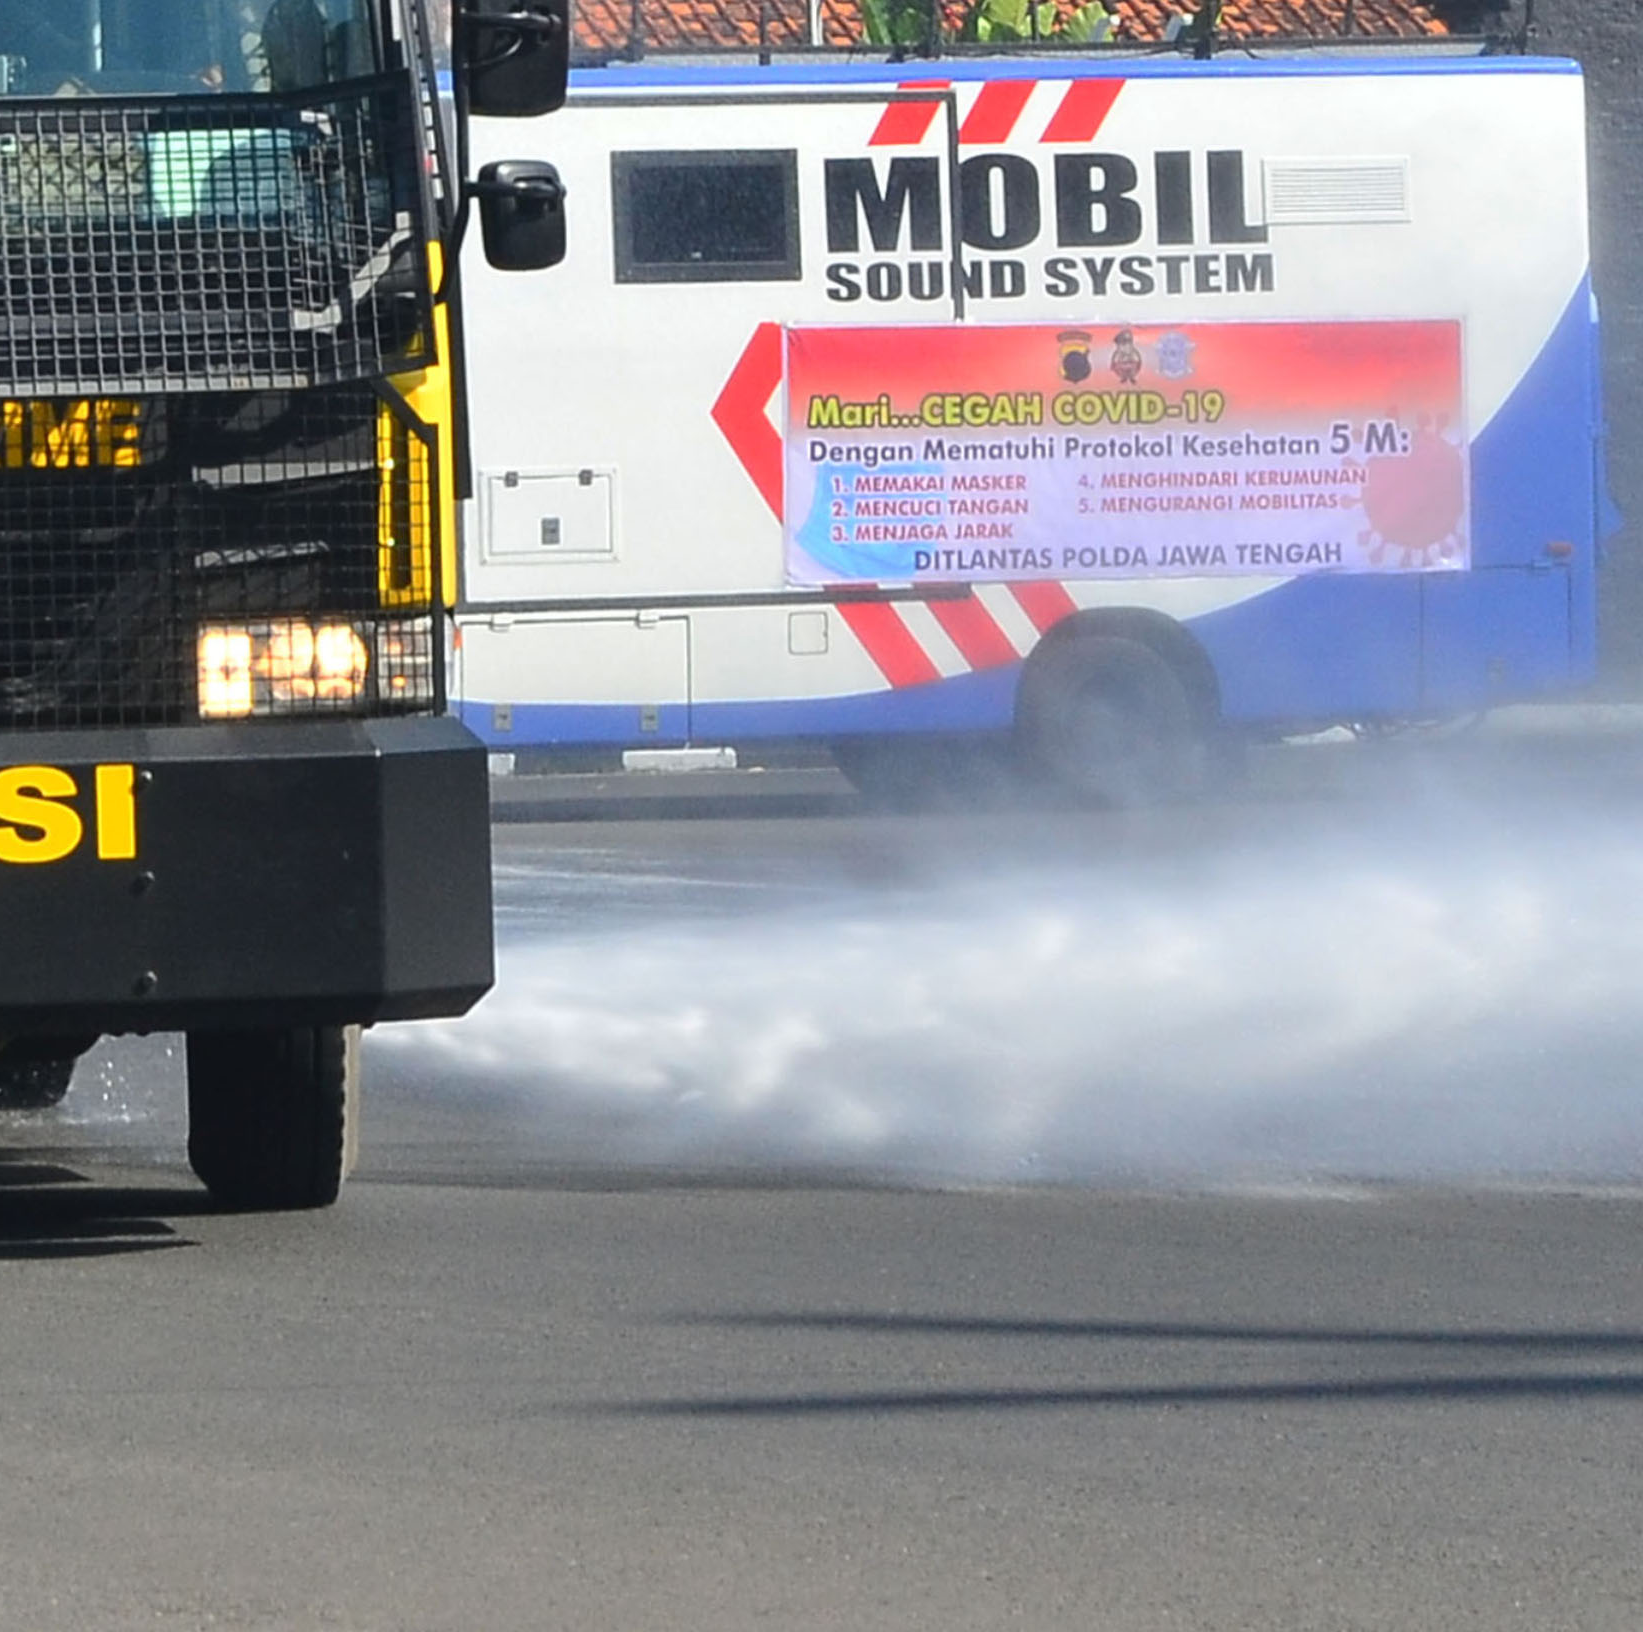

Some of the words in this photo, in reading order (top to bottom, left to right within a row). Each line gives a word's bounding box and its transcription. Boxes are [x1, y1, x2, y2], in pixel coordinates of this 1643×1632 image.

[823, 149, 1270, 254] MOBIL
[826, 259, 1027, 302] SOUND
[1044, 253, 1275, 300] SYSTEM
[1052, 389, 1225, 426] COVID-19
[809, 440, 913, 467] Dengan
[923, 435, 1055, 461] Mematuhi
[1064, 434, 1172, 458] Protokol
[1182, 432, 1321, 457] Kesehatan
[1330, 423, 1351, 455] 5
[1365, 421, 1410, 454] M:
[832, 476, 849, 493] 1.
[854, 475, 944, 493] MEMAKAI
[950, 474, 1027, 491] MASKER
[1078, 473, 1096, 489] 4.
[1100, 471, 1238, 489] MENGHINDARI
[1245, 469, 1367, 487] KERUMUNAN
[832, 500, 849, 518] 2.
[854, 499, 942, 517] MENCUCI
[947, 498, 1029, 515] TANGAN
[1078, 497, 1096, 514] 5.
[1100, 495, 1233, 513] MENGURANGI
[1239, 493, 1339, 511] MOBILITAS
[832, 525, 850, 542] 3.
[854, 524, 948, 542] MENJAGA
[954, 523, 1014, 540] JARAK
[914, 547, 1053, 571] DITLANTAS
[1062, 546, 1149, 568] POLDA
[1156, 545, 1227, 567] JAWA
[1235, 542, 1342, 565] TENGAH
